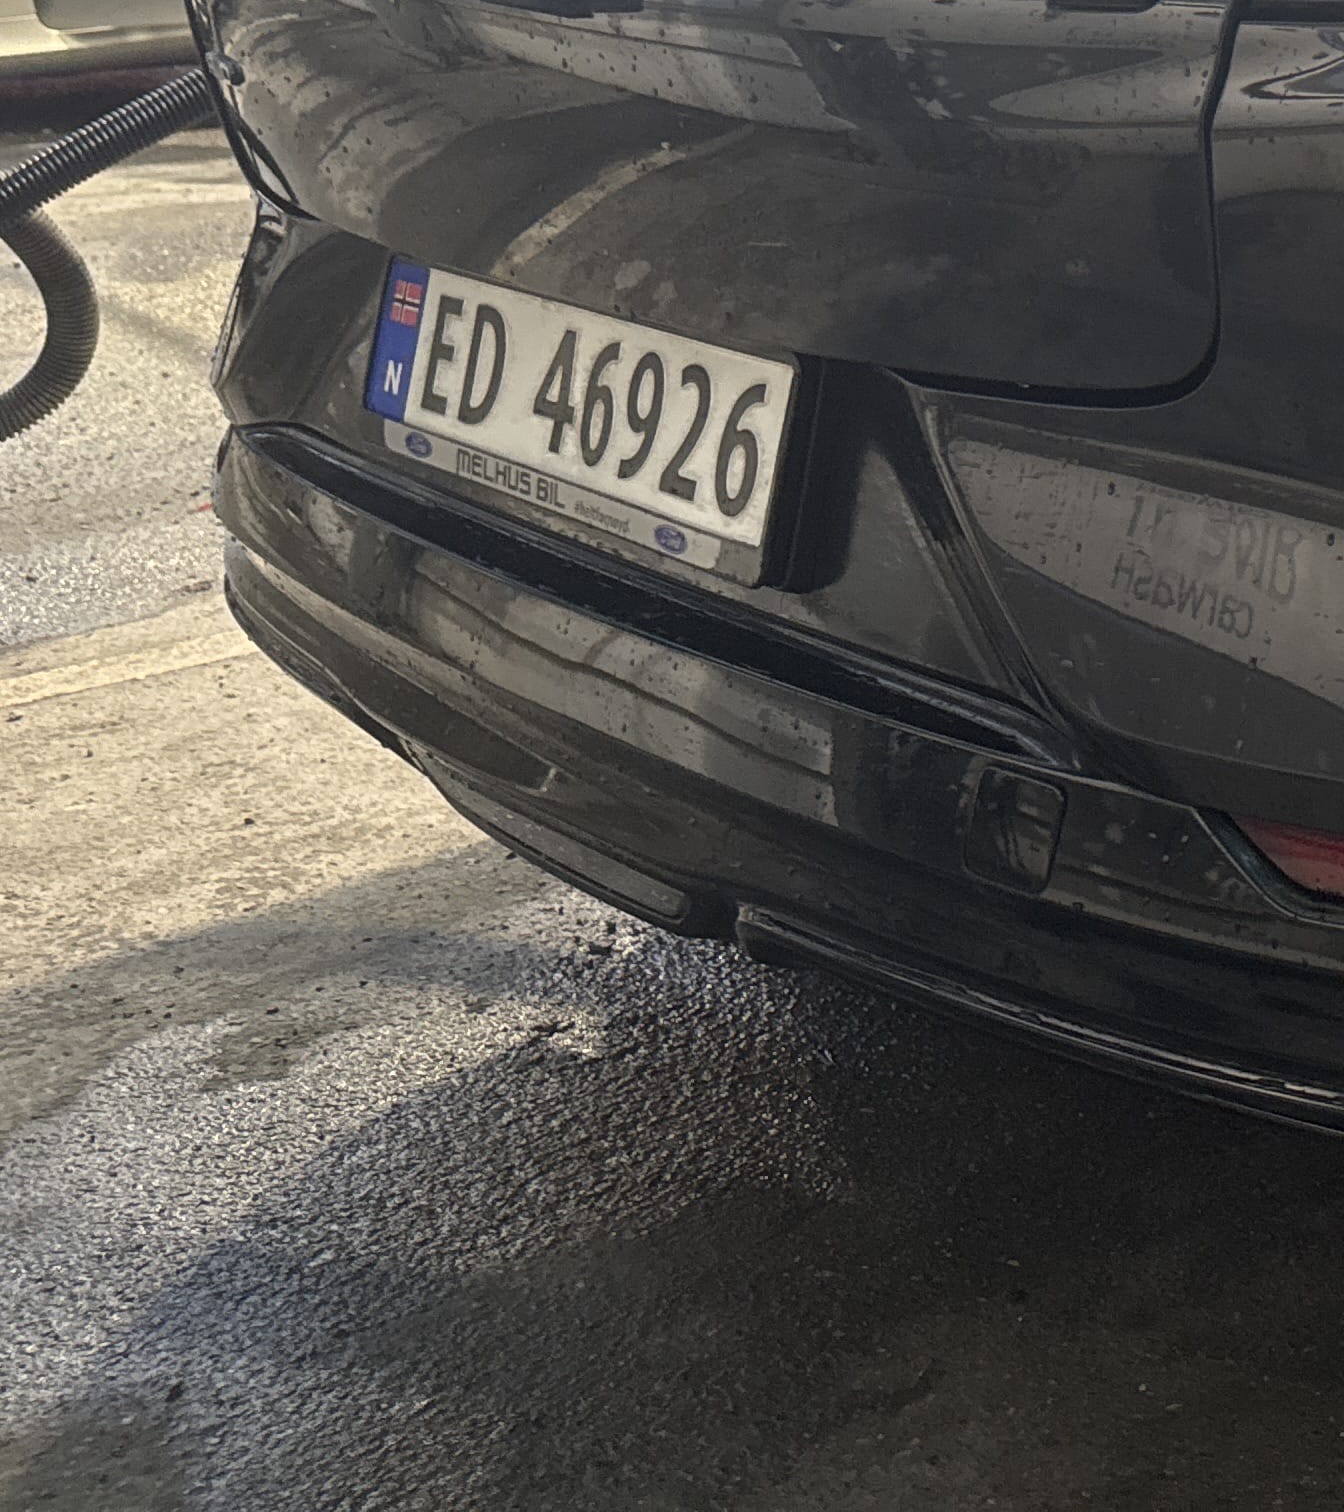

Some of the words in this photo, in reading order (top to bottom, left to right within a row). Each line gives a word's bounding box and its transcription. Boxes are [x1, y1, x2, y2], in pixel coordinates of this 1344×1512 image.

[383, 359, 402, 396] N
[420, 294, 506, 425] ED
[532, 330, 767, 518] 46926
[456, 448, 531, 498] MELHUS
[535, 476, 566, 510] BIL
